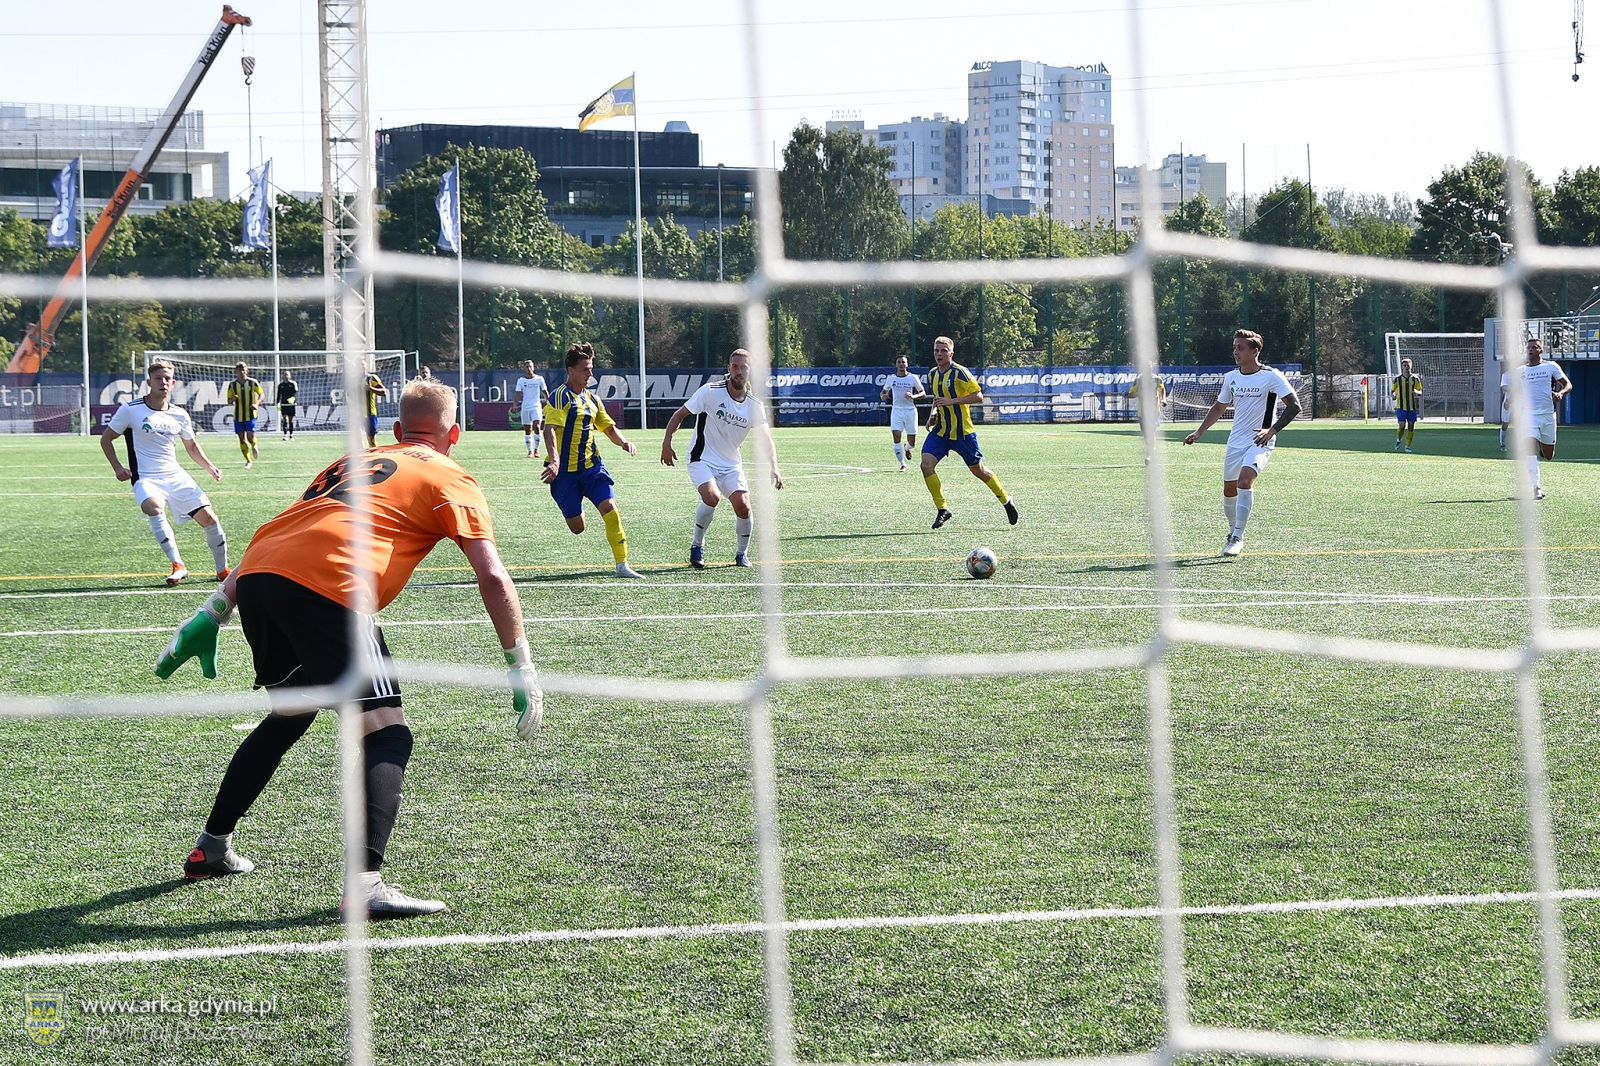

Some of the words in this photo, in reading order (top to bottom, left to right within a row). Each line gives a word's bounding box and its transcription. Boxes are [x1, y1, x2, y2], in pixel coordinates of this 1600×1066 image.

[970, 60, 998, 71] ALLCO
[765, 375, 818, 387] GDYNIA
[820, 374, 873, 387] GDYNIA
[986, 374, 1039, 387] GDYNIA
[1040, 372, 1093, 386] GDYNIA
[725, 411, 748, 424] ZAJAZD
